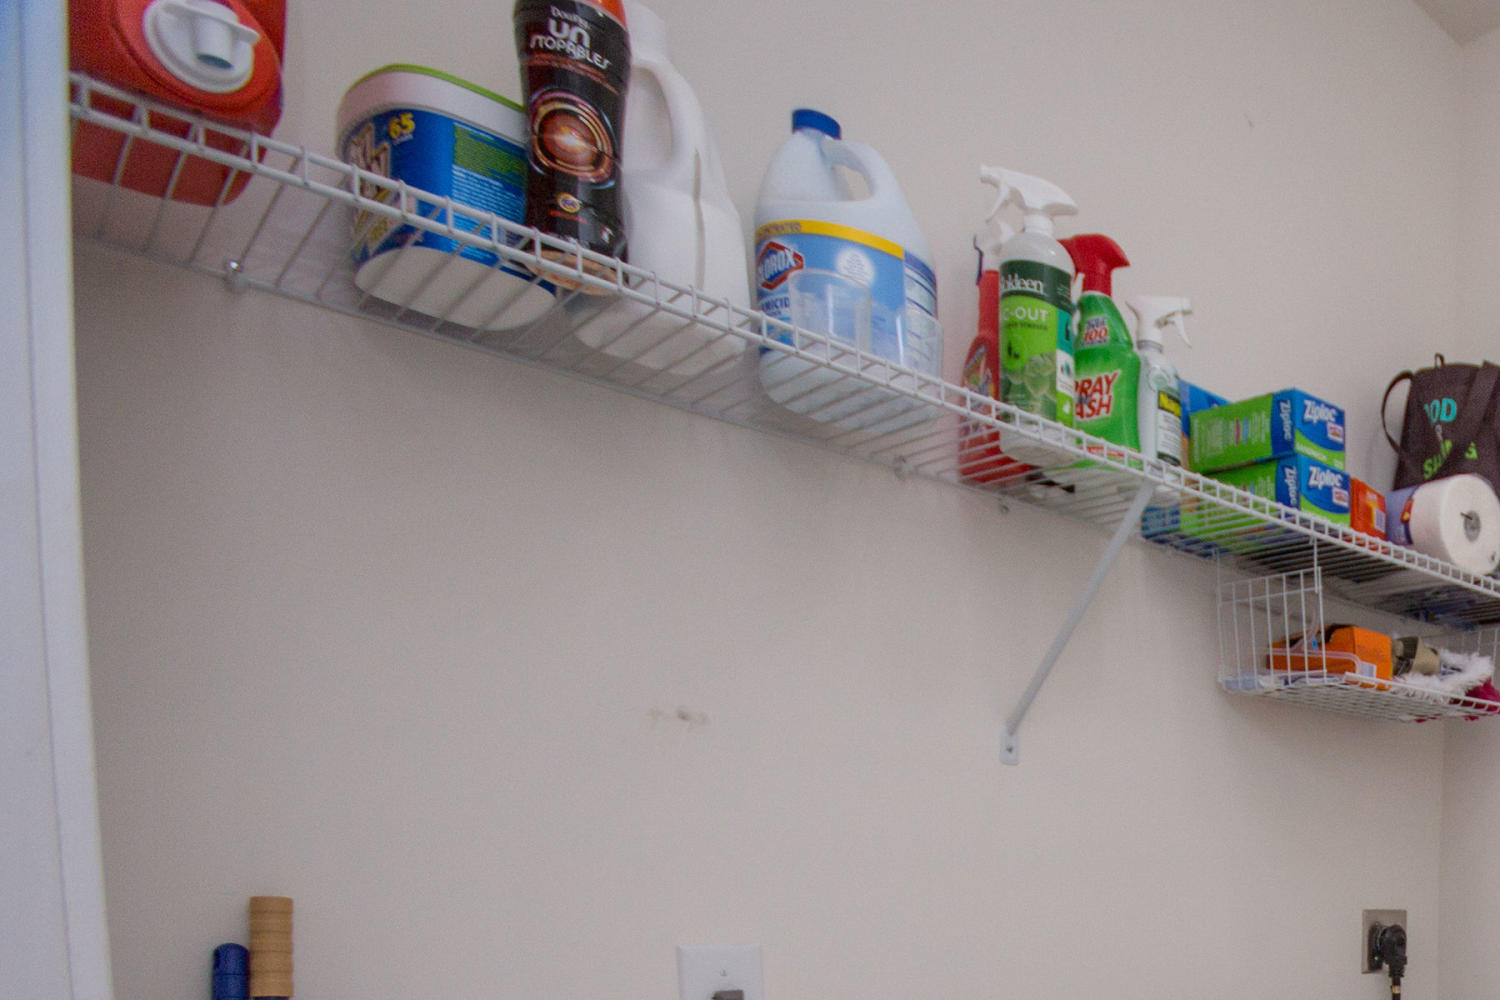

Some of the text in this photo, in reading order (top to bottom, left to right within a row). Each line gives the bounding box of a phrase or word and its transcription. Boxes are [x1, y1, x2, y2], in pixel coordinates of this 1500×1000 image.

[389, 112, 416, 139] 65
[759, 248, 797, 282] LOROX
[1075, 395, 1112, 420] ASH
[1279, 399, 1294, 441] Ziploc
[1303, 399, 1338, 423] Ziploc
[1284, 465, 1298, 506] Ziploc
[1308, 465, 1344, 489] Ziploc
